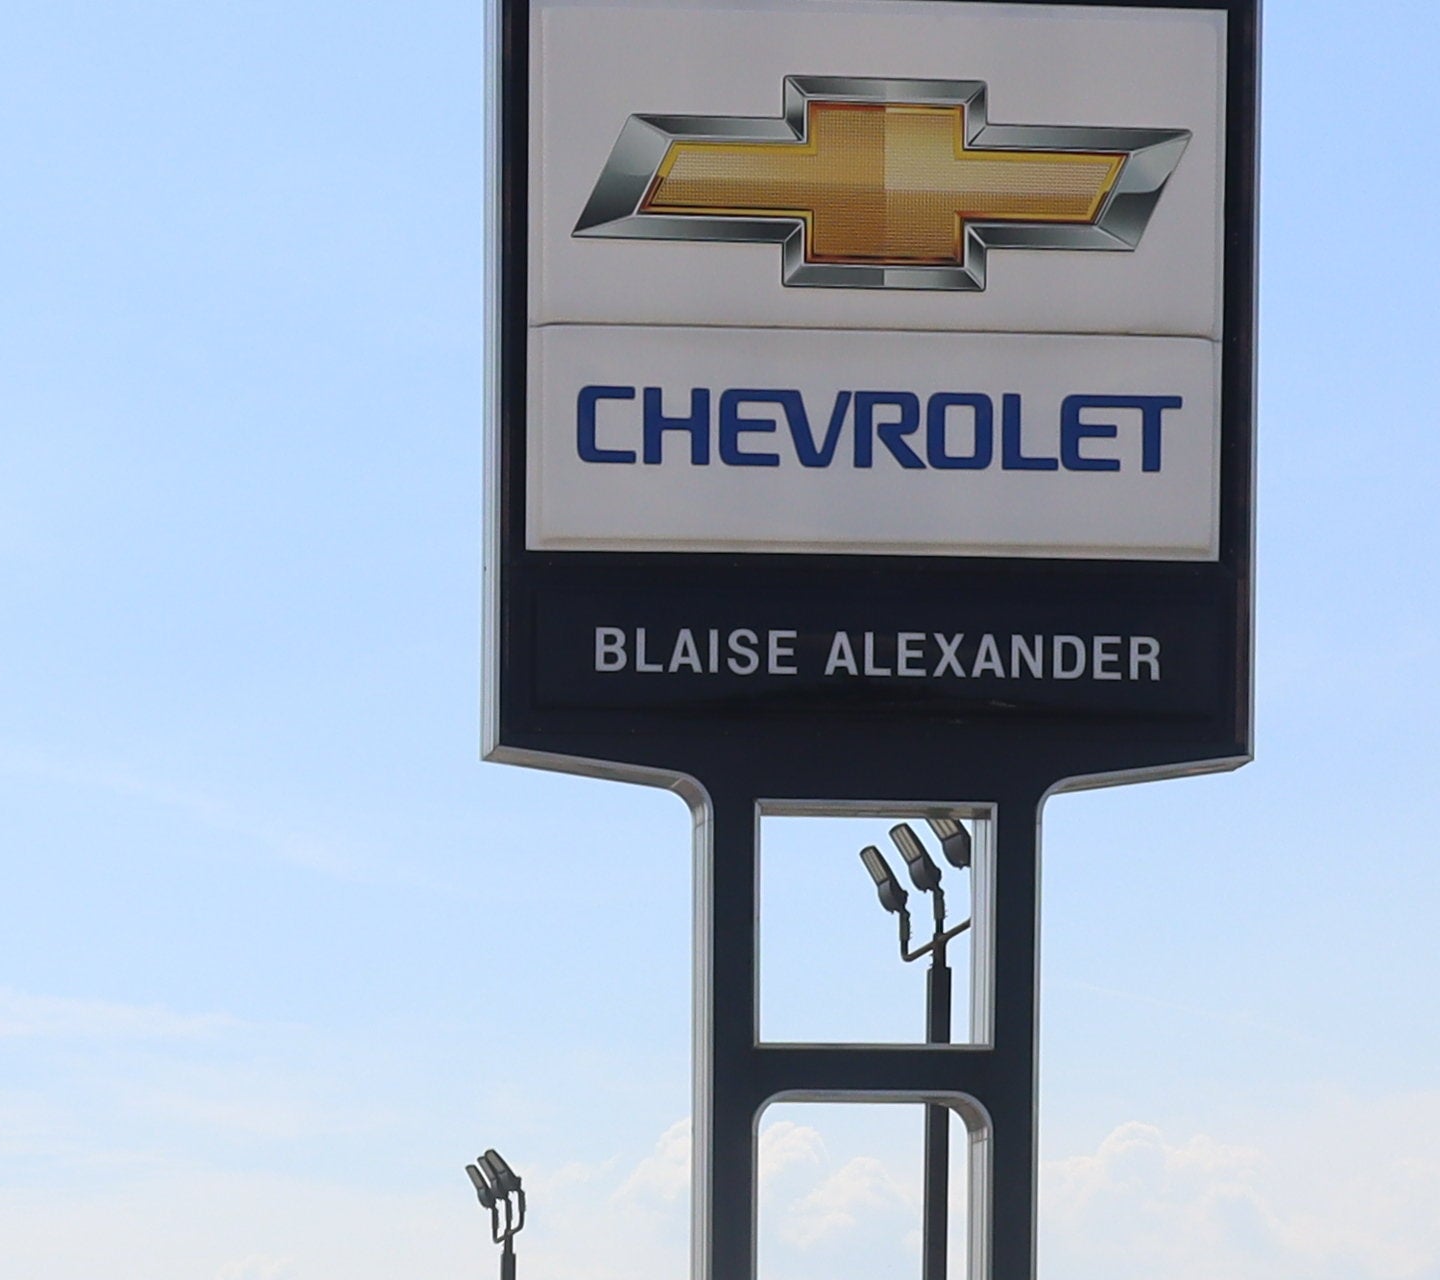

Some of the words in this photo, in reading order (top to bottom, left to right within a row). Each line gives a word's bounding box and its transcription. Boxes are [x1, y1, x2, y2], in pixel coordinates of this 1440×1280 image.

[577, 385, 1182, 472] CHEVROLET
[594, 626, 798, 675] BLAISE
[824, 631, 1161, 680] ALEXANDER
